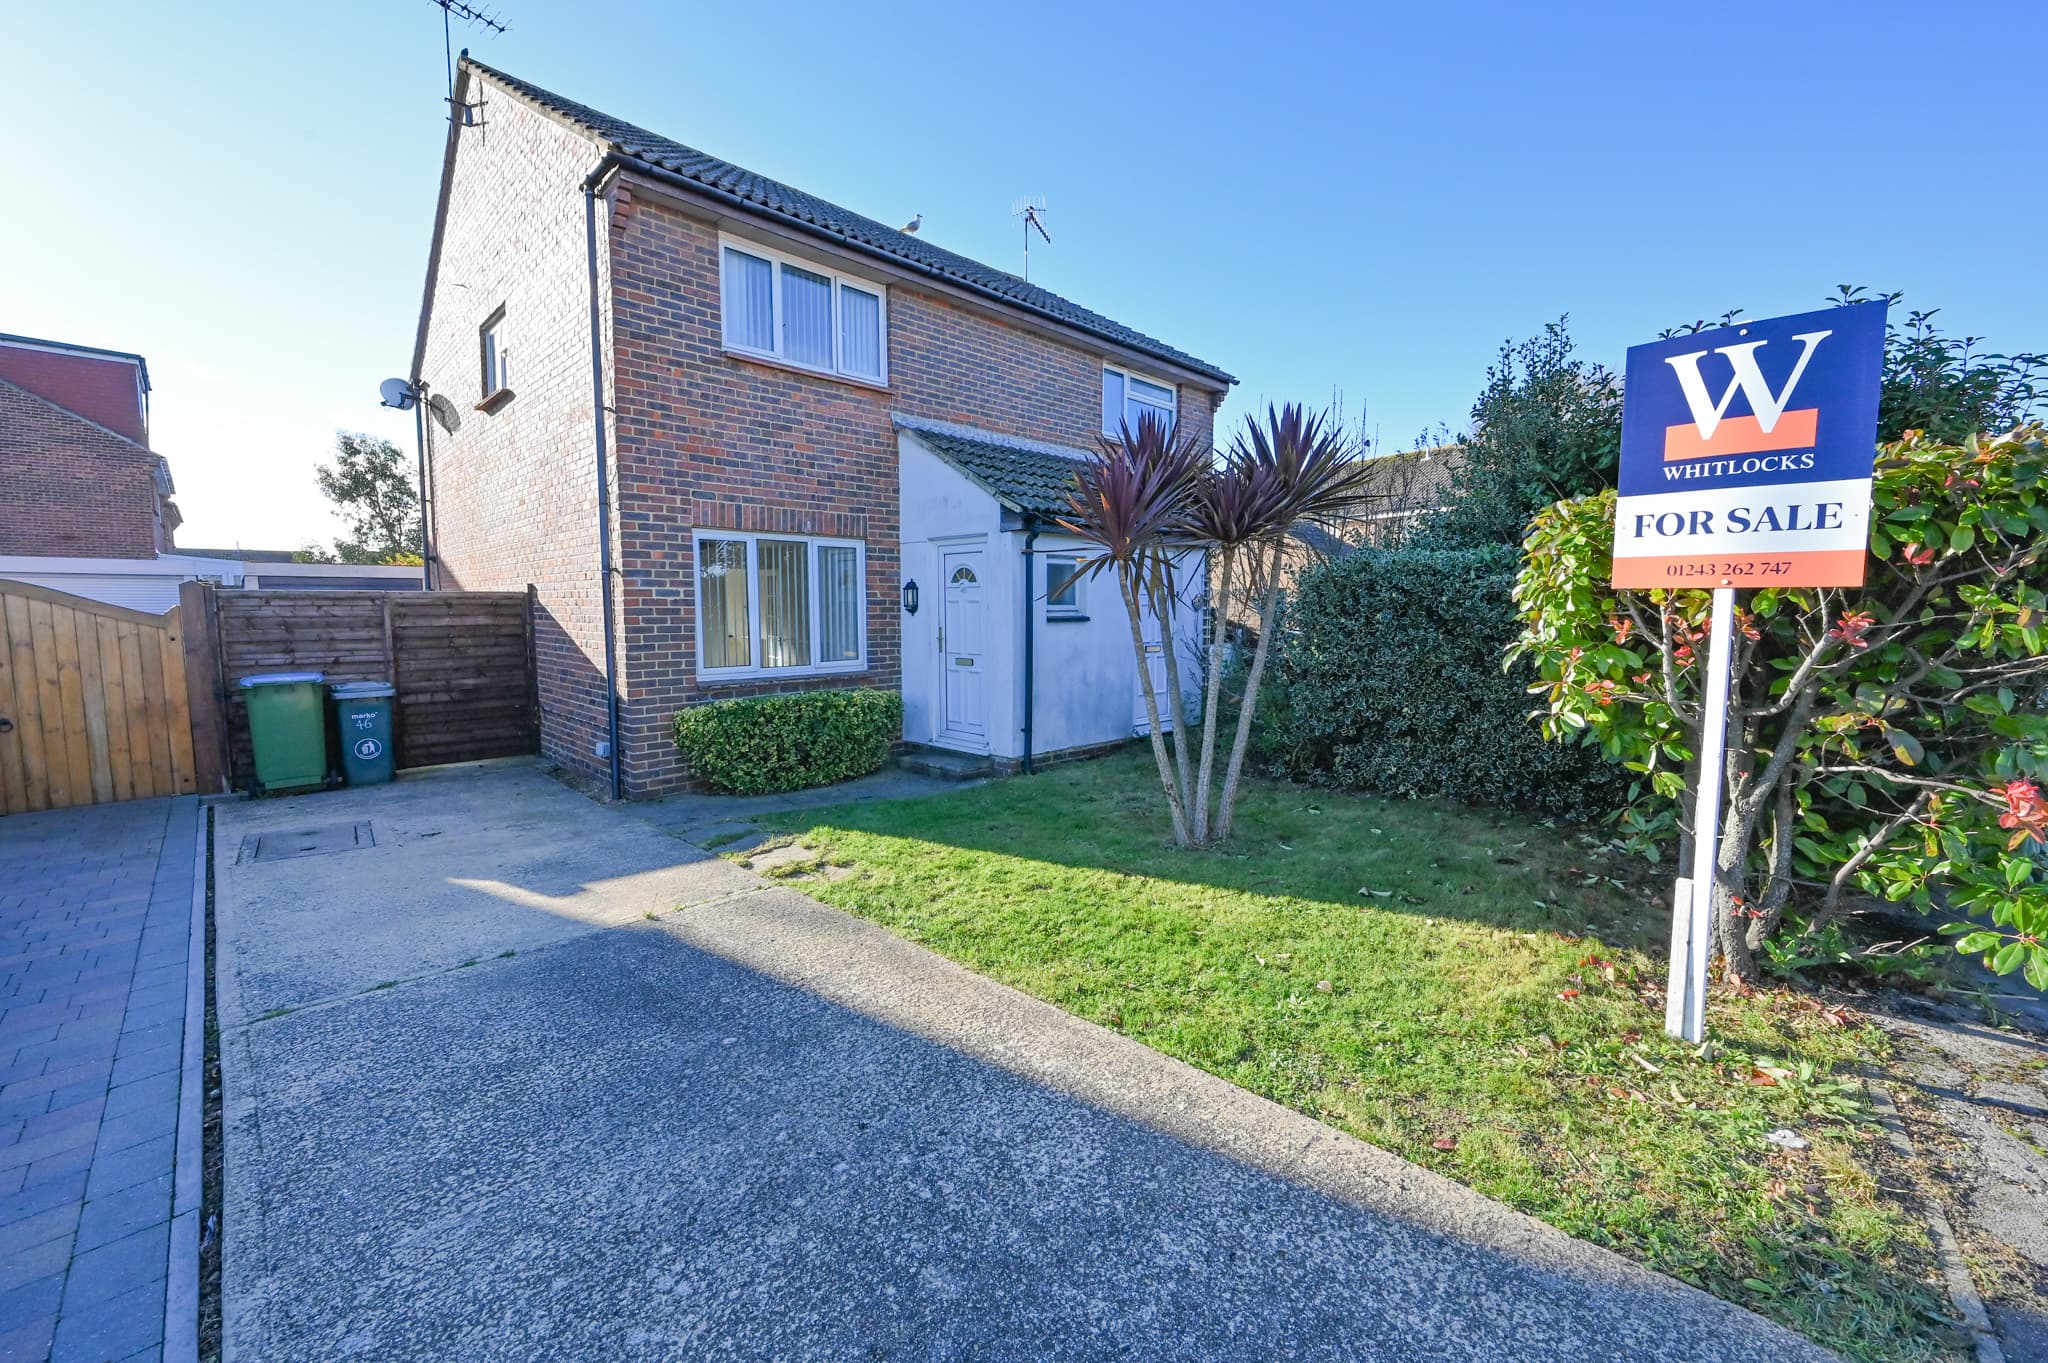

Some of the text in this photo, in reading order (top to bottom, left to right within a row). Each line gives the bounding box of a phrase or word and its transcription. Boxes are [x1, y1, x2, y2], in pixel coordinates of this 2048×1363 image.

[1665, 329, 1833, 441] W
[1663, 453, 1815, 481] WHITLOCKS
[1633, 502, 1843, 538] FOR SALE
[1666, 562, 1792, 577] 01243 262 747
[356, 719, 373, 731] 46
